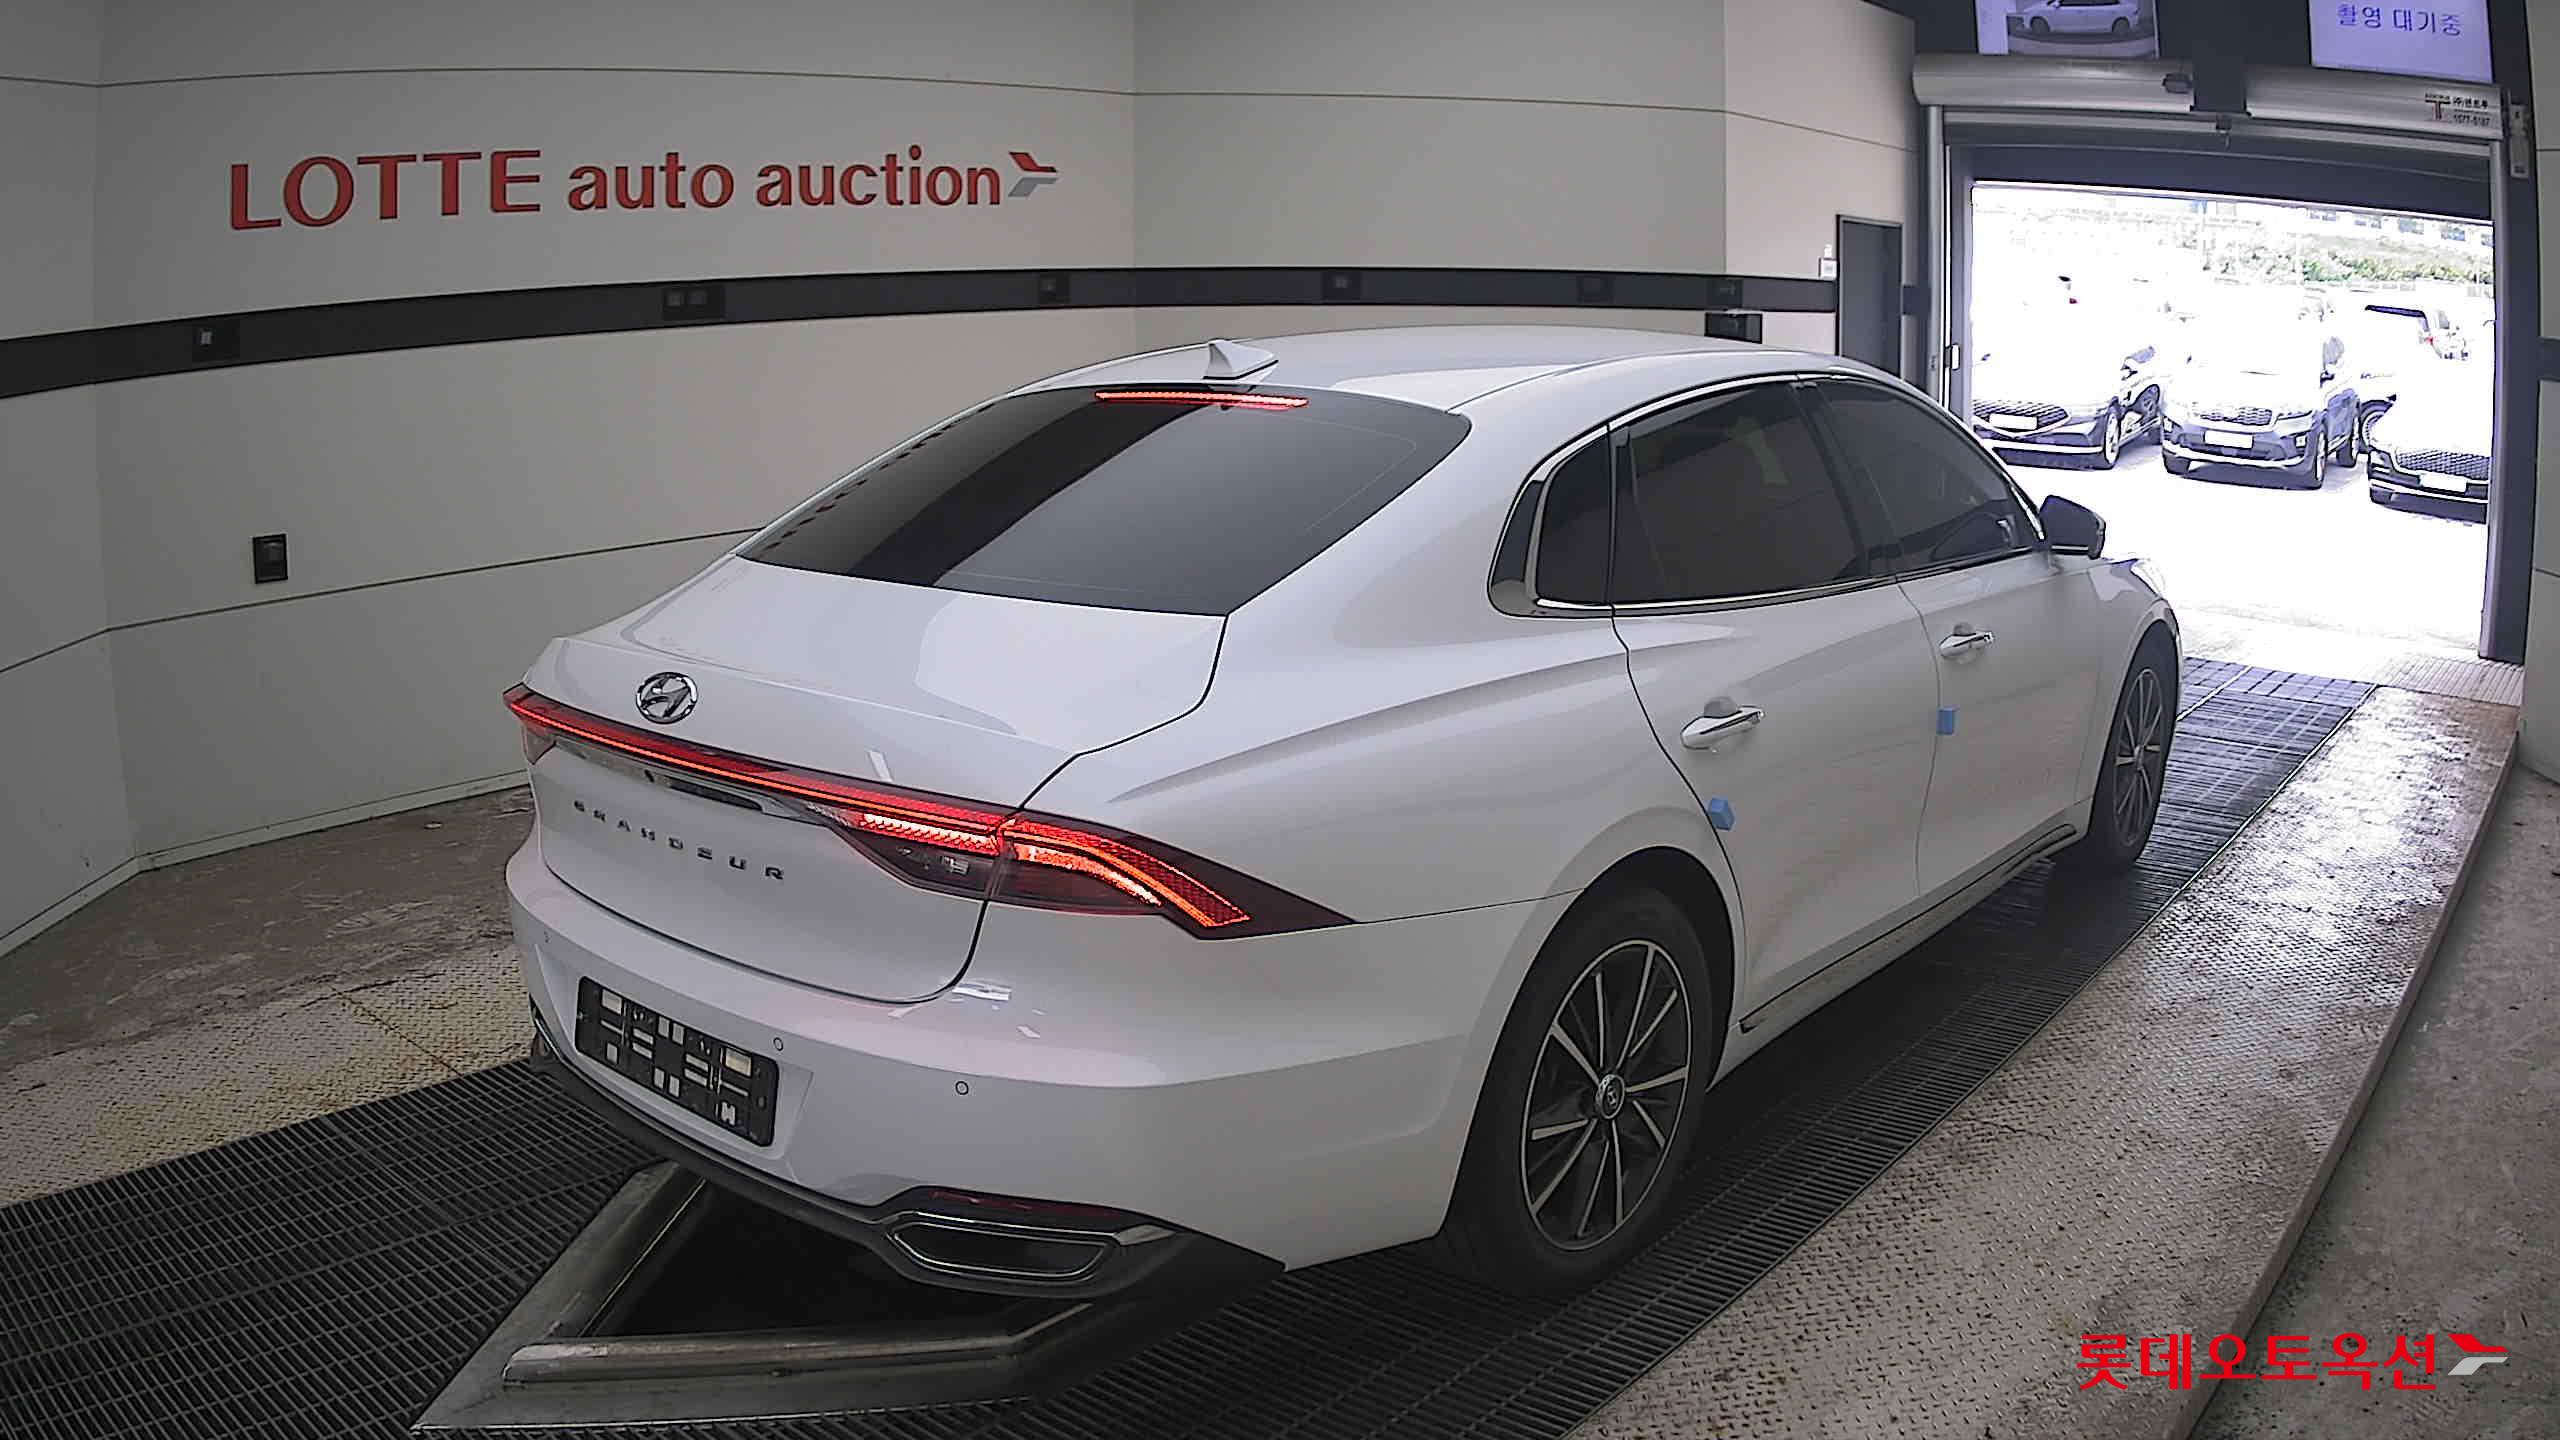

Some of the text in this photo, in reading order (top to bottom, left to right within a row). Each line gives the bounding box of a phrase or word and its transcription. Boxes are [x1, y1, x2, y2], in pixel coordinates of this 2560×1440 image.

[2337, 3, 2462, 36] 촬영 대기중
[231, 146, 1002, 231] LOTTE auto auction
